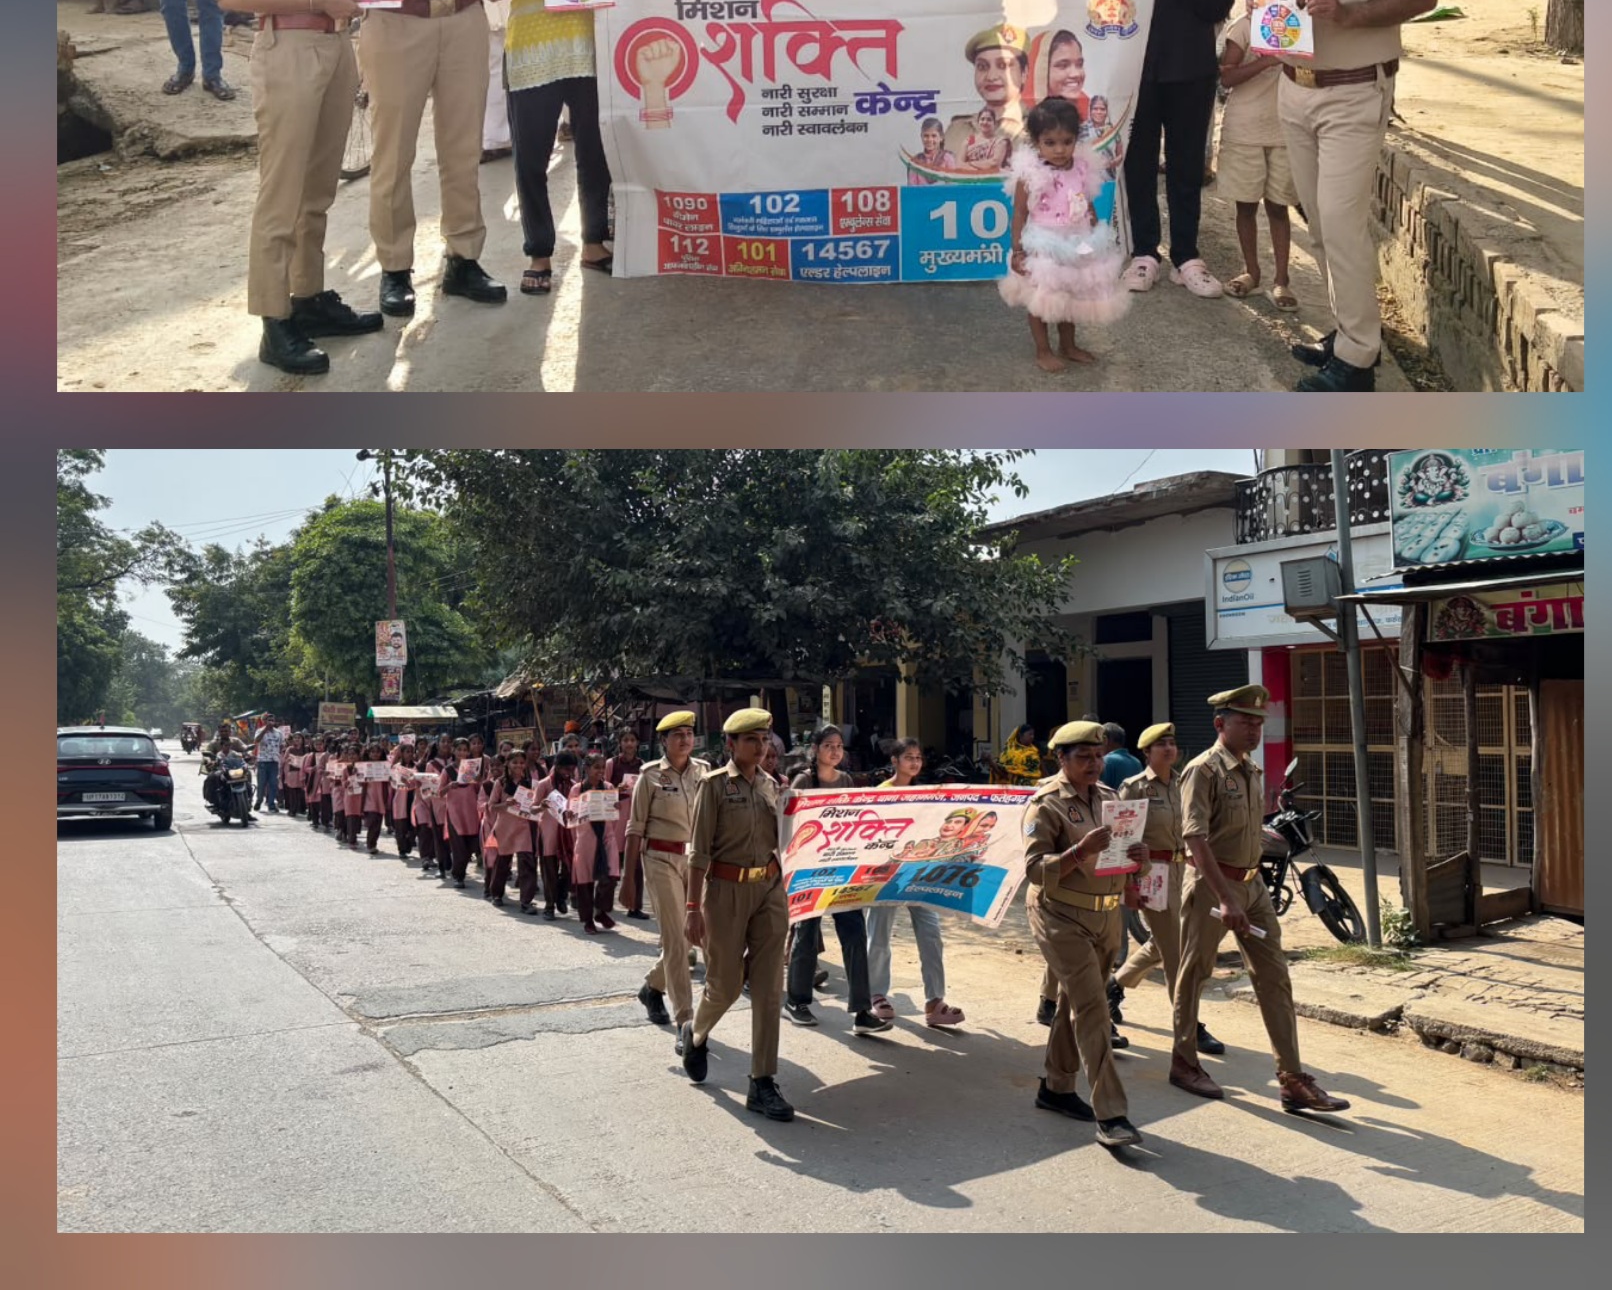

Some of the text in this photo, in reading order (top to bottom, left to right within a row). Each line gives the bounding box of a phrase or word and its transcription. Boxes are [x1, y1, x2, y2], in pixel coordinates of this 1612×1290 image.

[761, 84, 838, 104] नारी सुरक्षा
[853, 81, 940, 120] केन्द्र
[761, 103, 849, 118] नारी सम्मान
[761, 119, 869, 137] नारी स्वावलंबन
[663, 195, 708, 211] 1090
[749, 193, 800, 214] 102
[841, 190, 890, 212] 108
[875, 214, 891, 227] सेवा
[929, 199, 1009, 239] 10
[669, 234, 709, 255] 112
[737, 241, 776, 261] 101
[802, 239, 890, 260] 14567
[919, 242, 1002, 274] मुख्यमंत्री
[800, 263, 891, 279] एल्डर हेल्पलाइन
[1478, 449, 1584, 495] बंगा
[1222, 593, 1254, 603] IndianOil
[1490, 591, 1584, 632] बंगा
[819, 807, 862, 818] मिशन
[817, 809, 914, 853] शक्ति
[864, 839, 898, 850] केन्द्र
[811, 867, 837, 876] 102
[911, 864, 985, 888] 1076
[791, 892, 813, 904] 101
[832, 884, 874, 896] 14567
[904, 884, 964, 899] हेल्पलाइन
